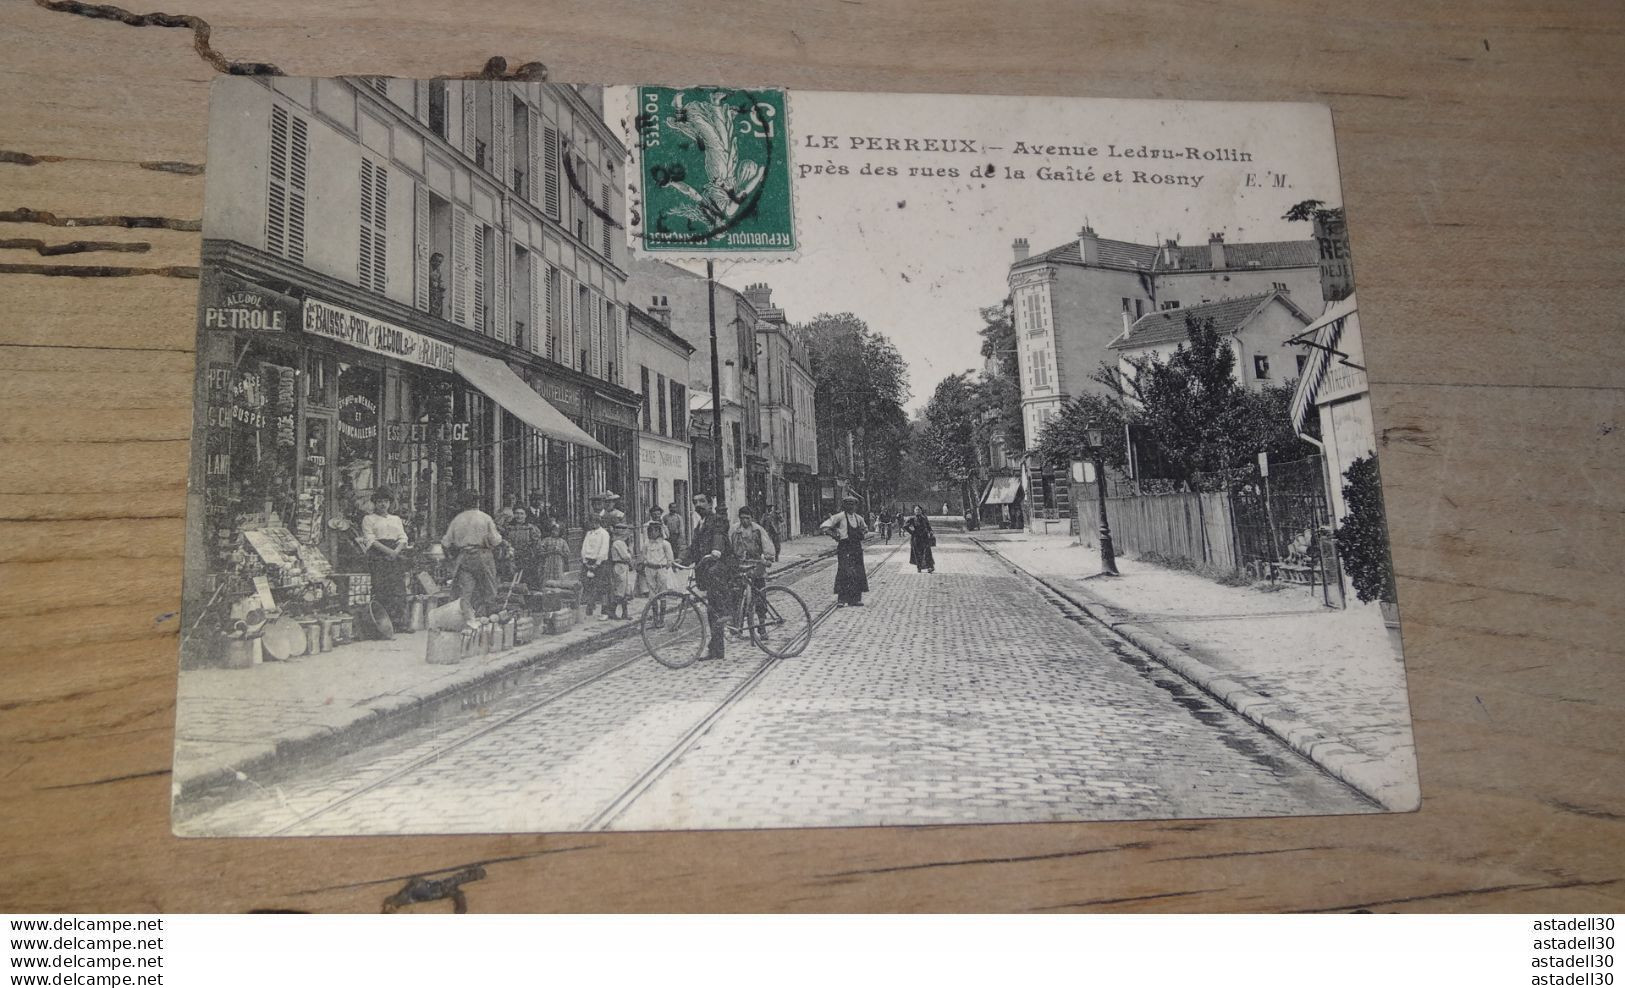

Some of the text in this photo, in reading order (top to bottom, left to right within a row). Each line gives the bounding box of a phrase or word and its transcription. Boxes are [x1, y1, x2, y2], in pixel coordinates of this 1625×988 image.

[645, 93, 660, 147] POSTES
[805, 134, 839, 149] LE
[1012, 141, 1098, 157] Avenue
[1108, 144, 1253, 162] Ledru-Rollin
[798, 160, 1205, 188] près des rues de la Gaîté et Rosny
[227, 293, 262, 307] ALCOOL
